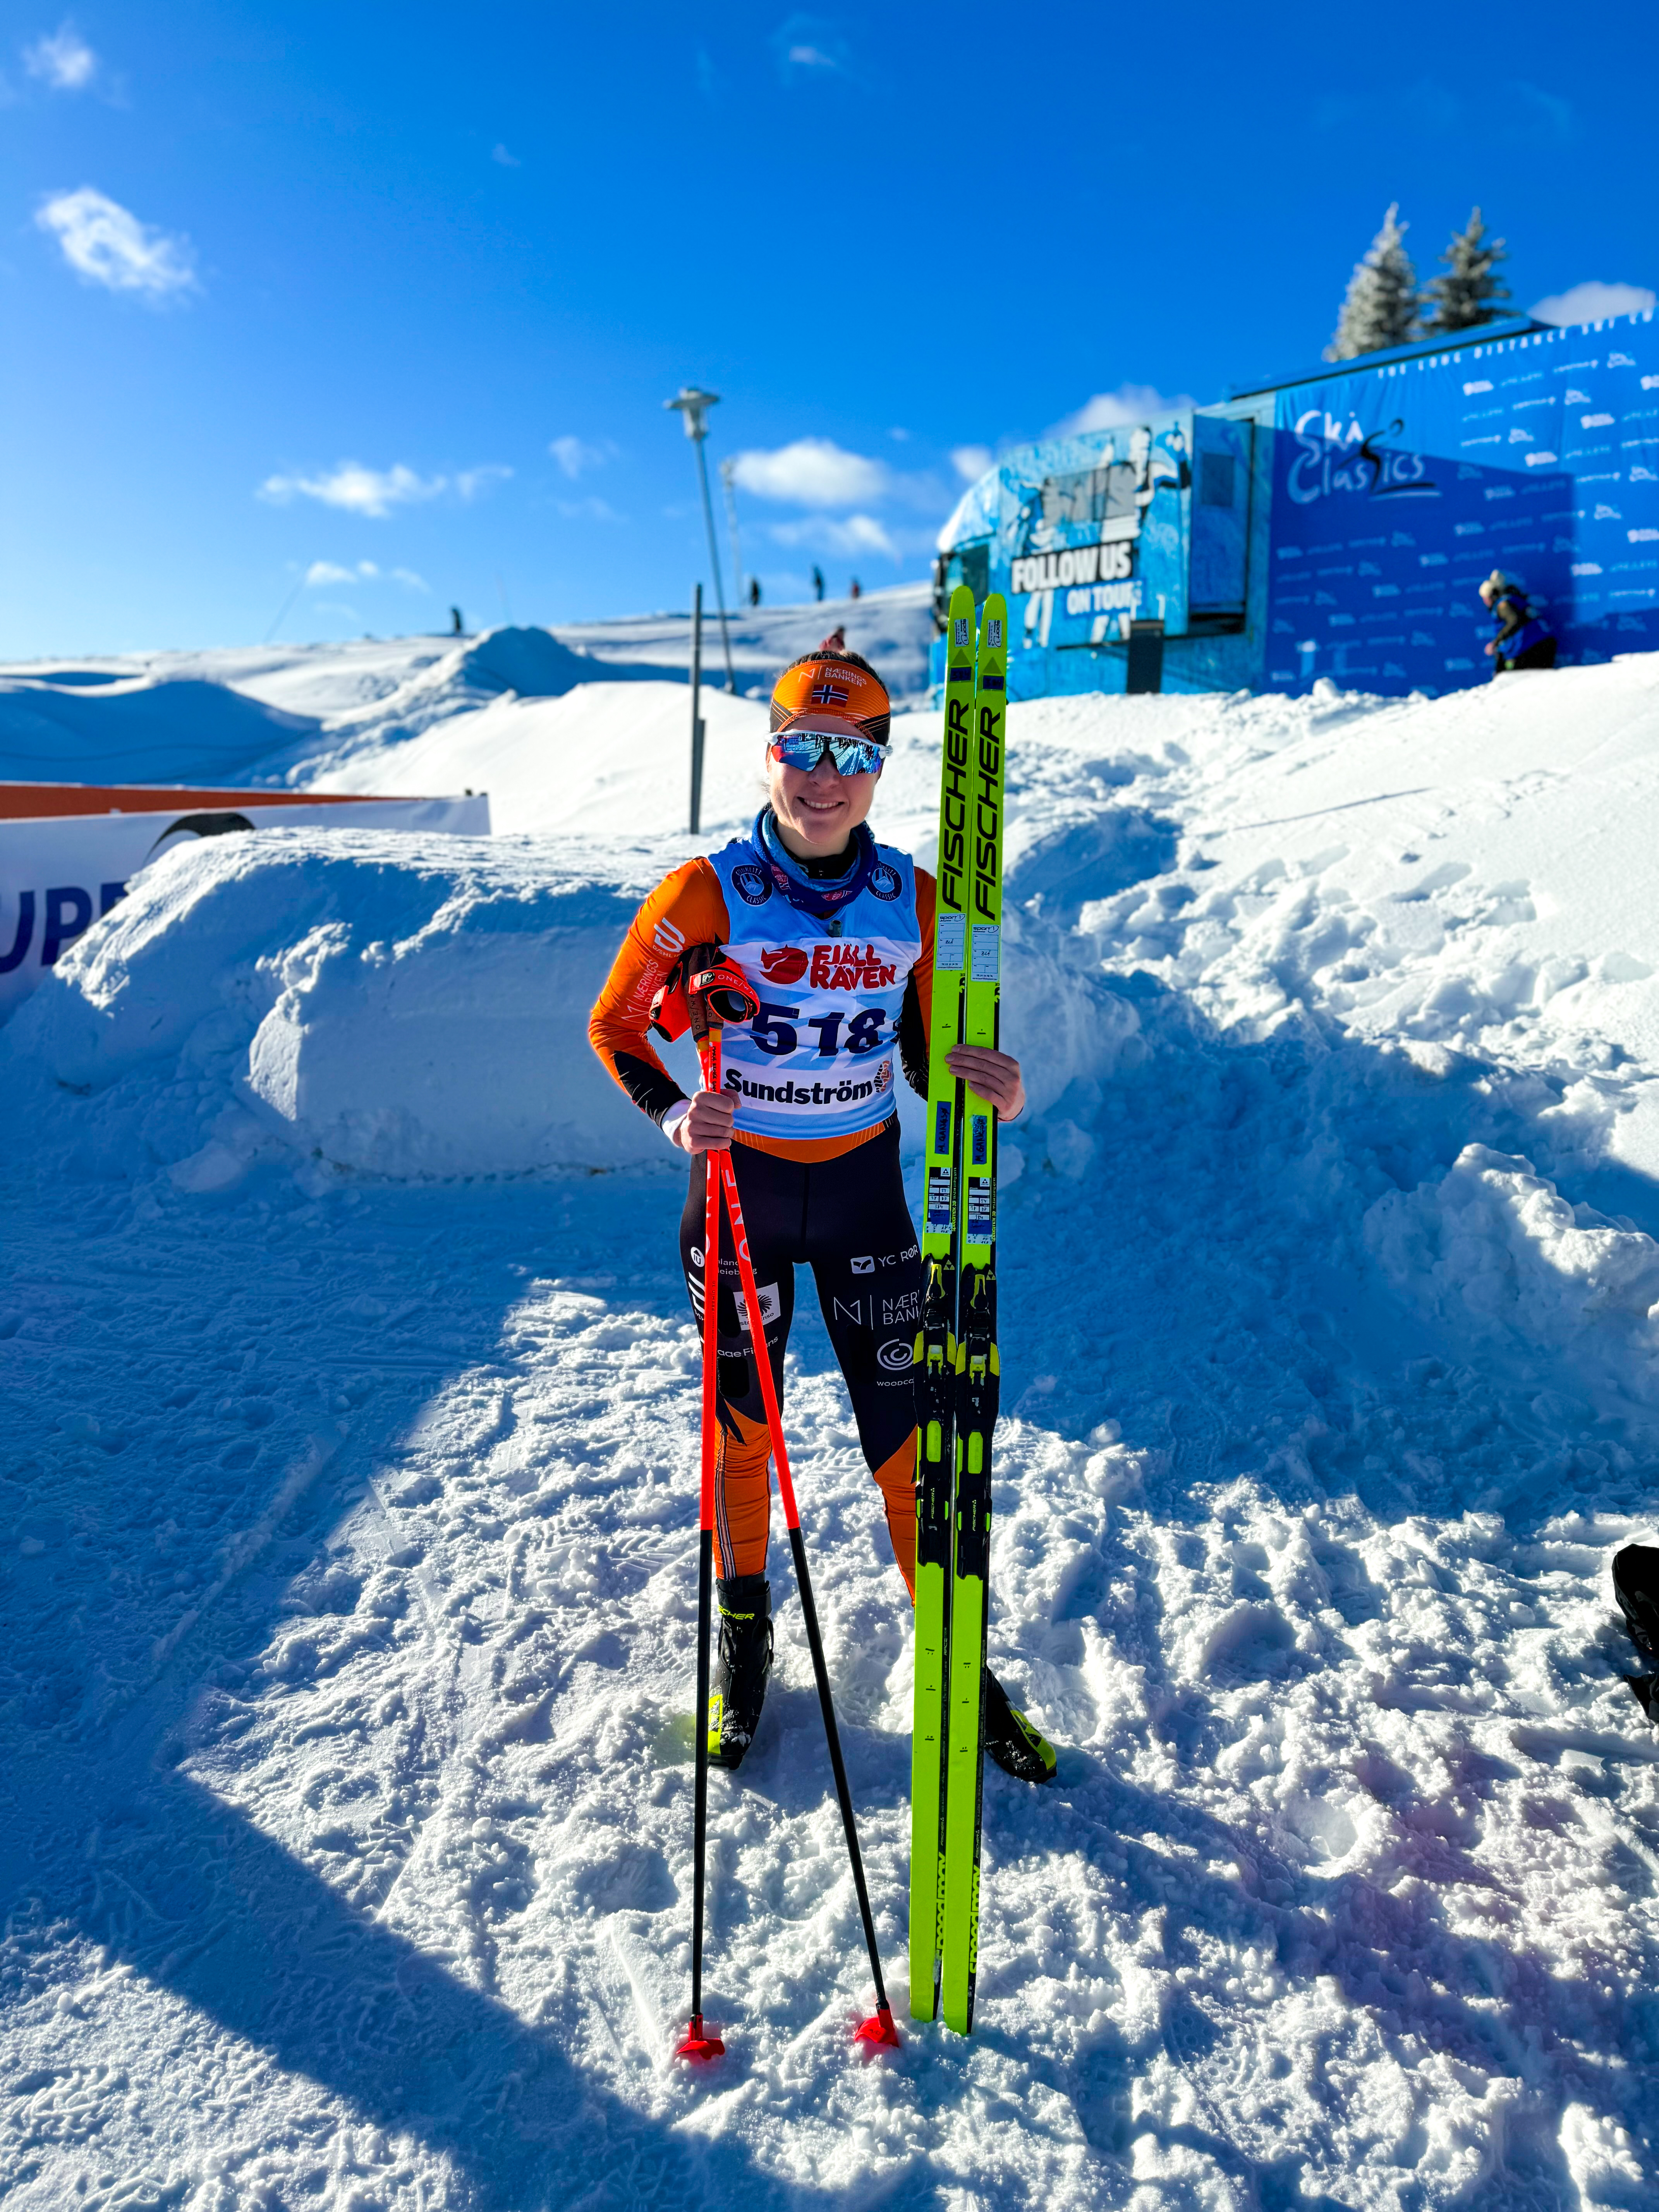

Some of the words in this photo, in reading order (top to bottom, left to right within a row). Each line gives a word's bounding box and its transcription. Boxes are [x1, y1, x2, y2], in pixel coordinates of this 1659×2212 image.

[1295, 410, 1364, 469] Ski
[1011, 545, 1099, 594] FOLLOW
[1099, 541, 1132, 580] US
[1066, 587, 1091, 615] ON
[825, 672, 862, 687] BANKEN
[826, 667, 867, 685] NÆRINGS
[941, 698, 969, 912] FISCHER
[975, 706, 1001, 921] FISCHER
[747, 895, 767, 904] CLASSIC
[876, 891, 896, 900] CLASSIC
[812, 943, 881, 967] FJÄLL
[633, 959, 659, 1001] NÆRINGS
[810, 964, 897, 991] RÄVEN
[749, 1001, 886, 1057] 518
[723, 1068, 873, 1105] Sundström
[878, 1255, 896, 1267] YC
[900, 1244, 918, 1262] RØR
[969, 1864, 980, 1974] speedmax
